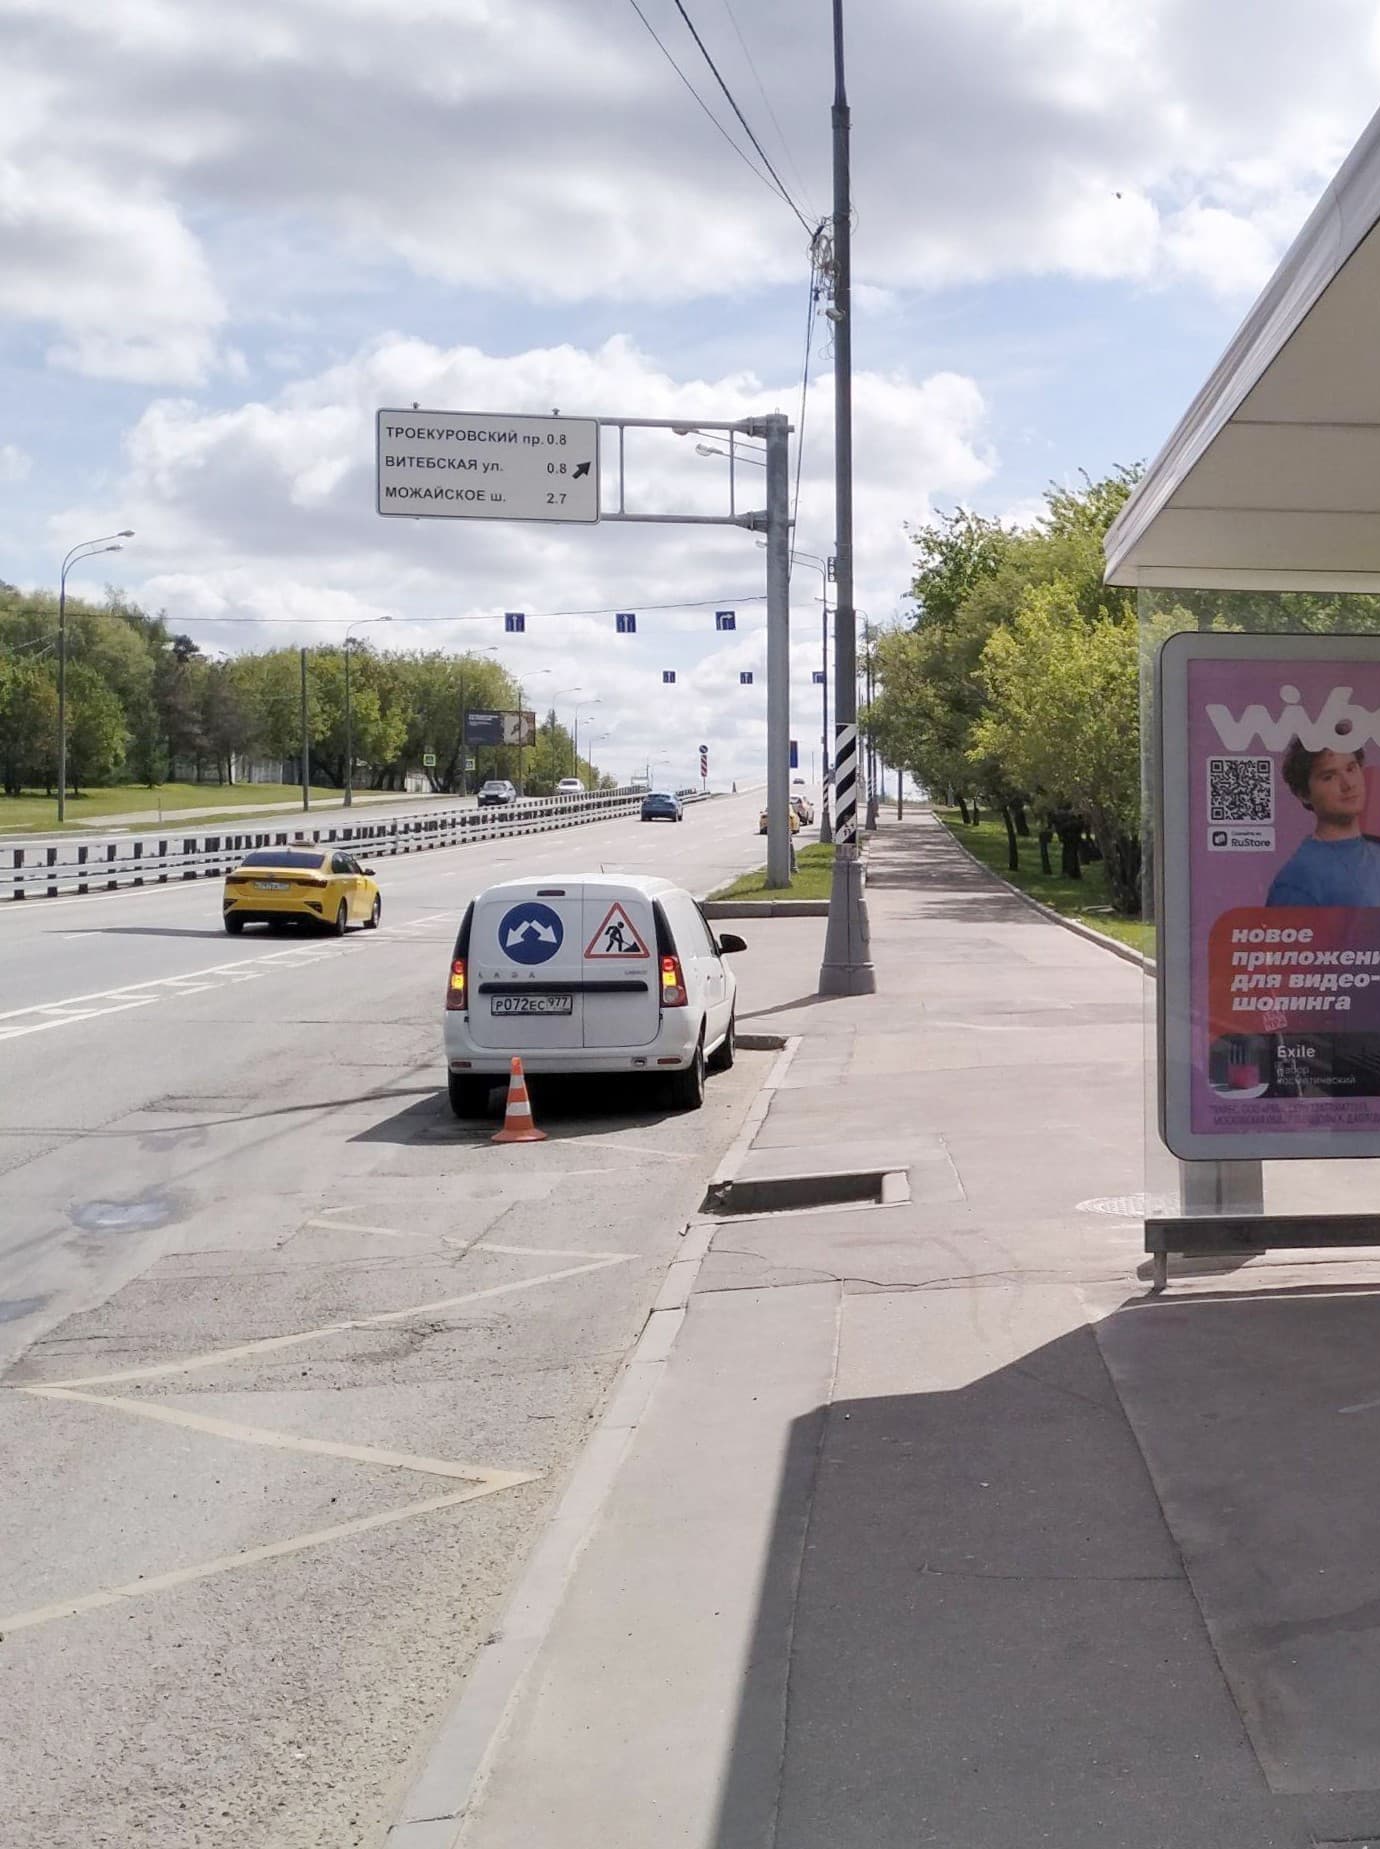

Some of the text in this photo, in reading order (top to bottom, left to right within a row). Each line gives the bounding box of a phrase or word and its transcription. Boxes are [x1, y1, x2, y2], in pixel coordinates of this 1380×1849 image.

[386, 426, 567, 447] ТРОЕКУРОВСКИЙ пр. 0.8
[385, 455, 567, 474] ВИТЕБСКАЯ ул. 0.8
[385, 485, 567, 504] МОЖАЙСКОЕ ш. 2.7
[1231, 838, 1271, 848] RuStore
[1231, 928, 1313, 944] новое
[1230, 973, 1380, 992] для видео-
[1231, 994, 1351, 1012] шопинга
[1276, 1045, 1316, 1058] Exile
